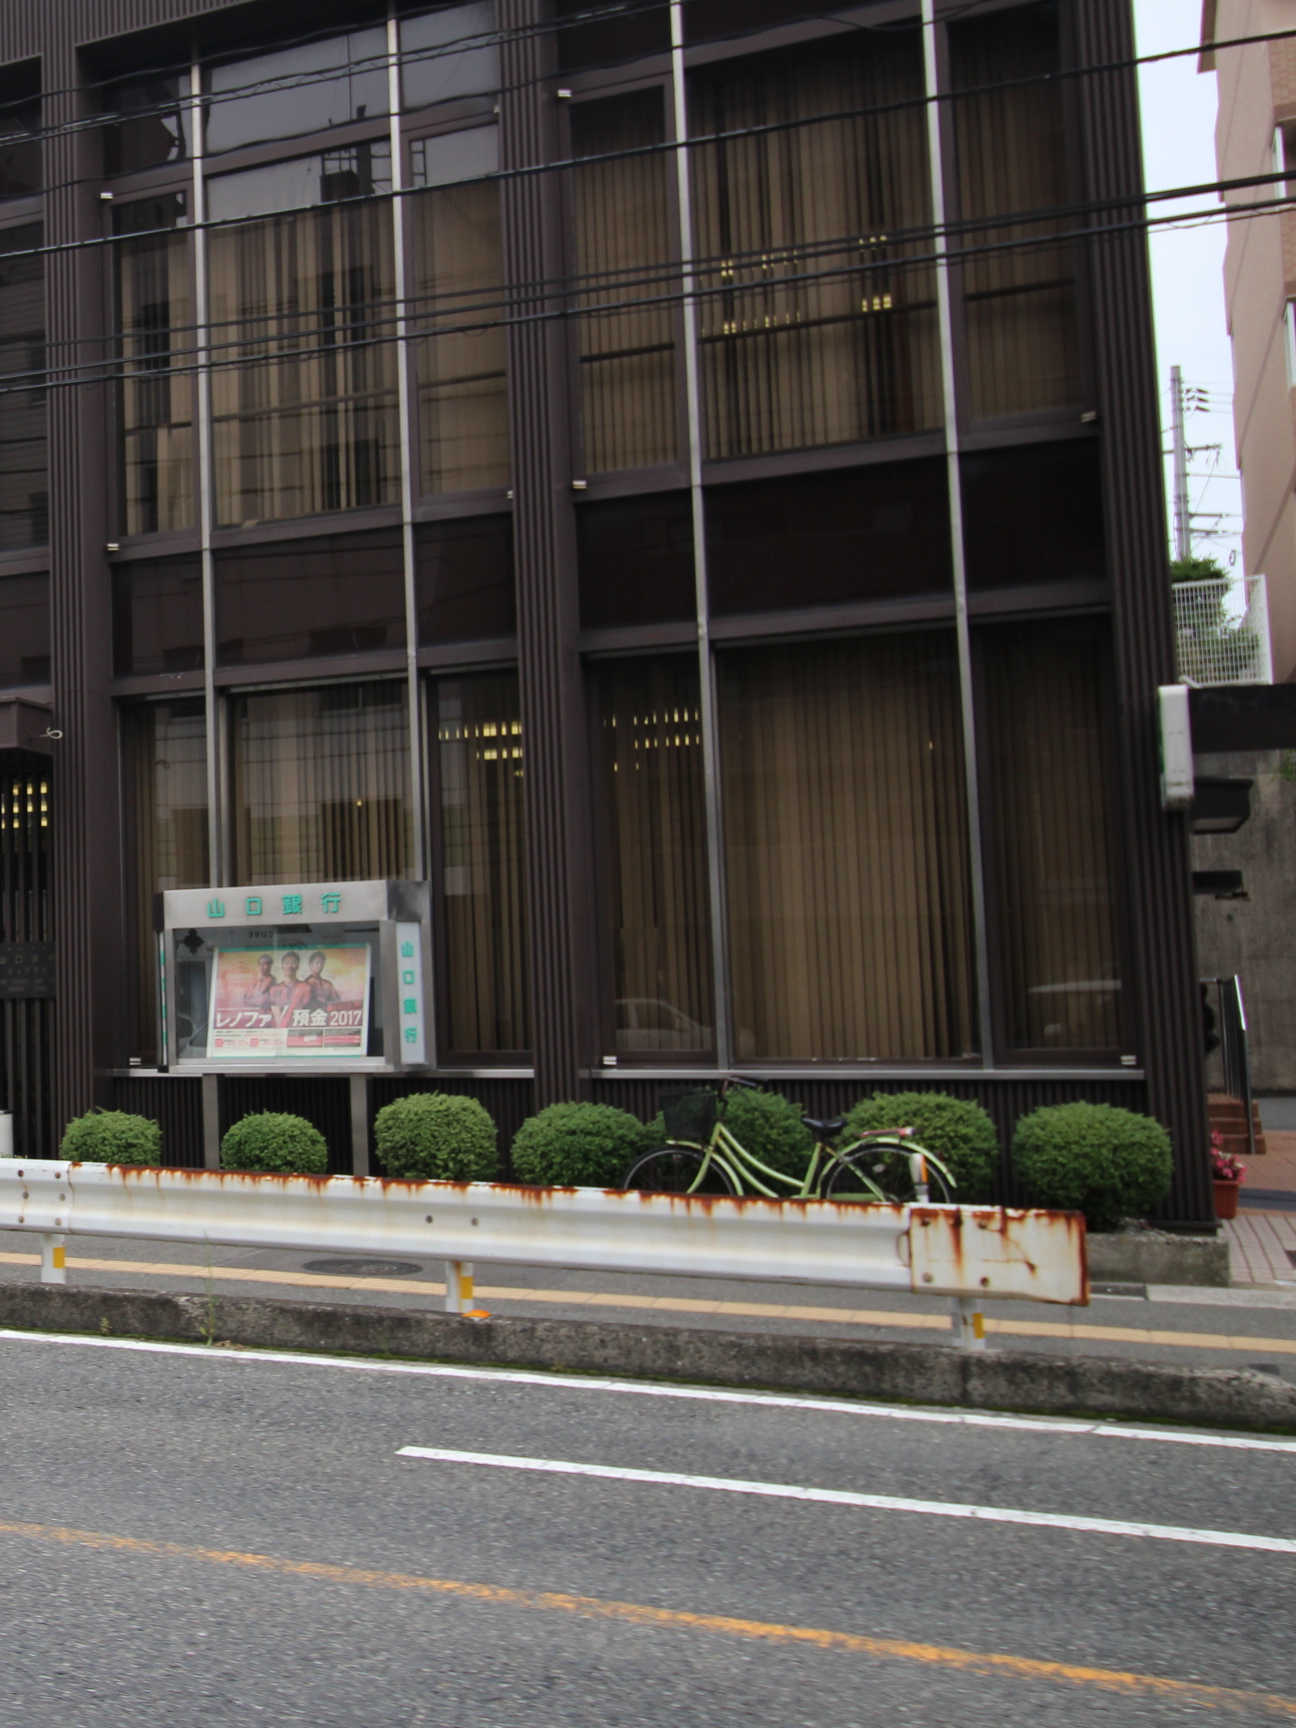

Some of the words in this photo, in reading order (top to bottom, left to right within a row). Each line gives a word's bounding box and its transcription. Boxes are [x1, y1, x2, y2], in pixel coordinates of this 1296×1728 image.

[207, 892, 341, 918] 山口銀行
[401, 941, 417, 1043] 山口銀行
[329, 1010, 363, 1026] 2017
